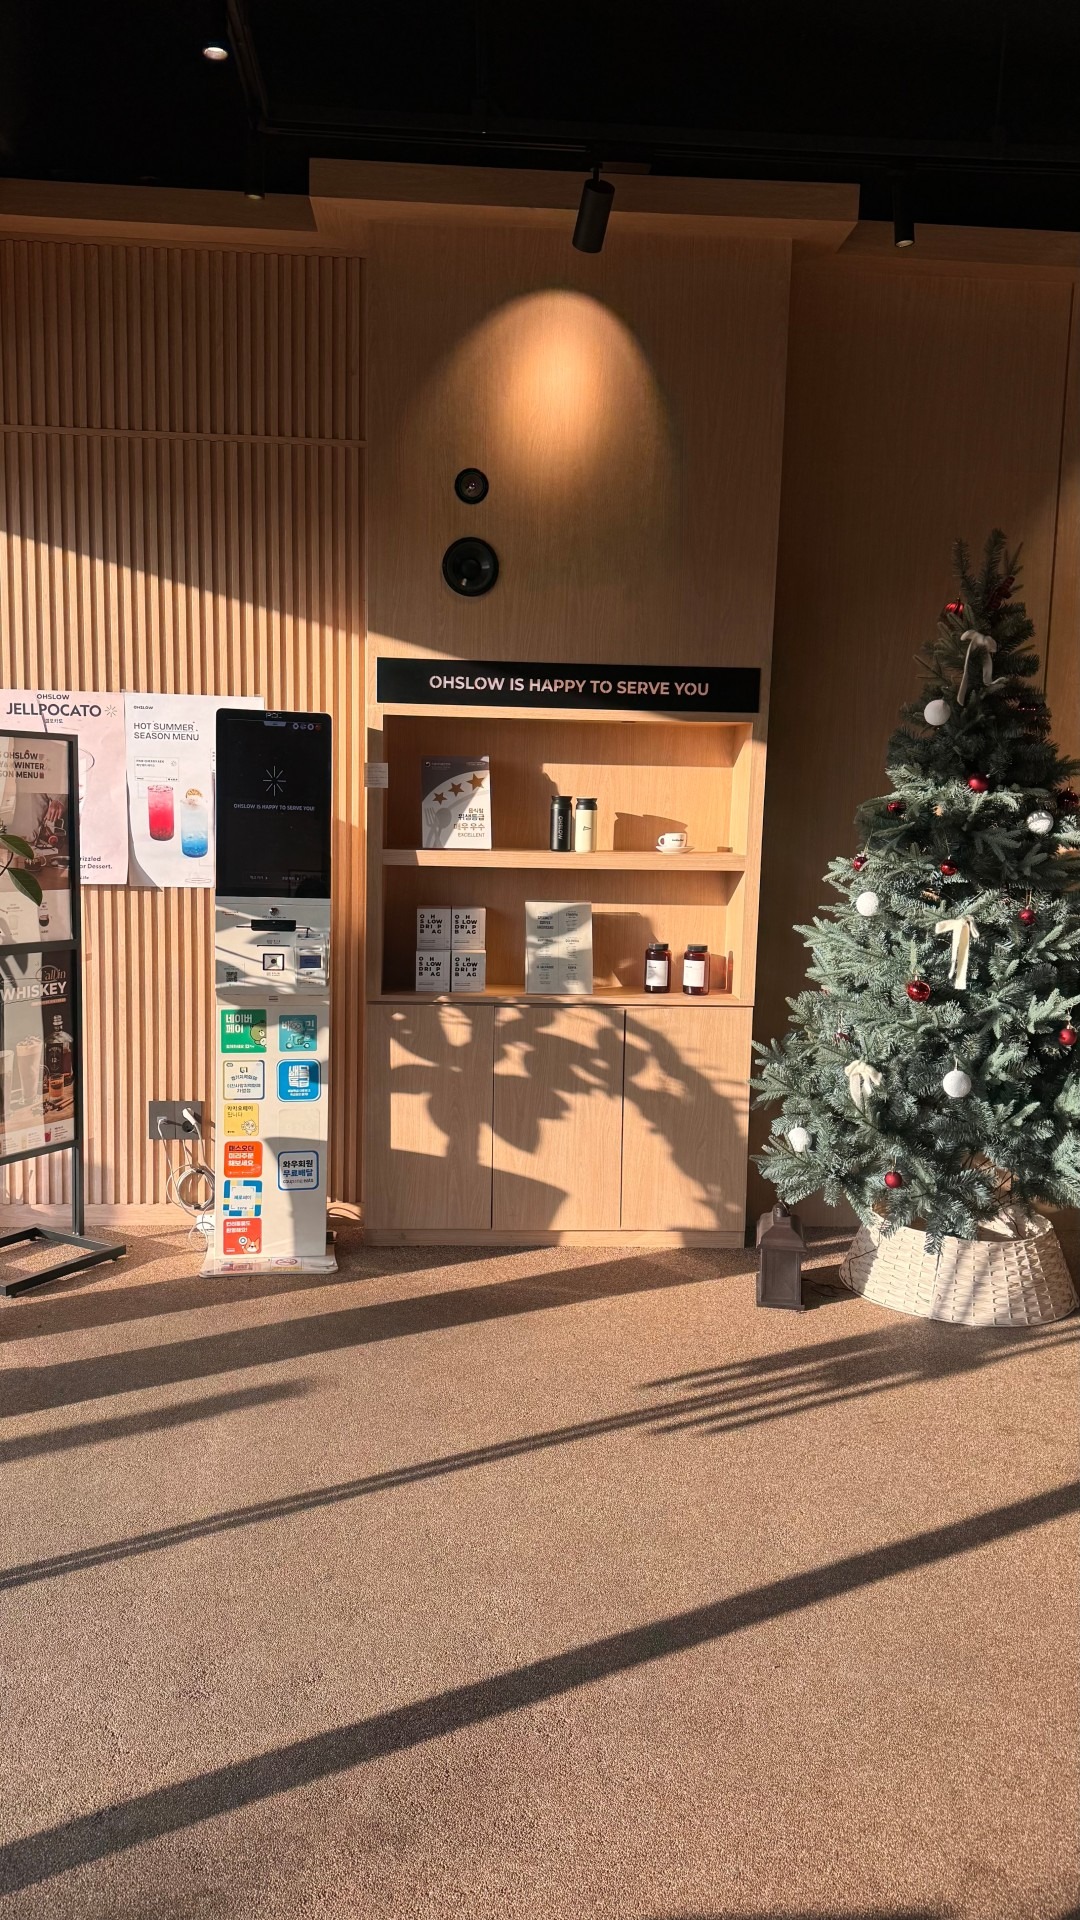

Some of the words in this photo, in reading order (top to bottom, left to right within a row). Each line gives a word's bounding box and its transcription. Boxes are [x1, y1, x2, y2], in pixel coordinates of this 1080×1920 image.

[429, 675, 505, 691] OHSLOW
[509, 677, 525, 692] IS
[529, 678, 584, 694] HAPPY
[590, 680, 613, 694] TO
[616, 681, 670, 696] SERVE
[674, 682, 710, 696] YOU
[6, 702, 102, 717] JELLPOCATO
[134, 722, 152, 730] HOT
[154, 723, 194, 731] SUMMER
[134, 732, 170, 740] SEASON
[172, 733, 200, 741] MENU
[14, 762, 44, 770] WINTER
[16, 771, 38, 779] MENU
[470, 822, 485, 831] 우수
[0, 982, 66, 1000] WHISKEY
[226, 1014, 252, 1023] 네이버
[226, 1024, 244, 1033] 페이
[283, 1160, 313, 1168] 와우회원
[283, 1169, 313, 1177] 무료배달
